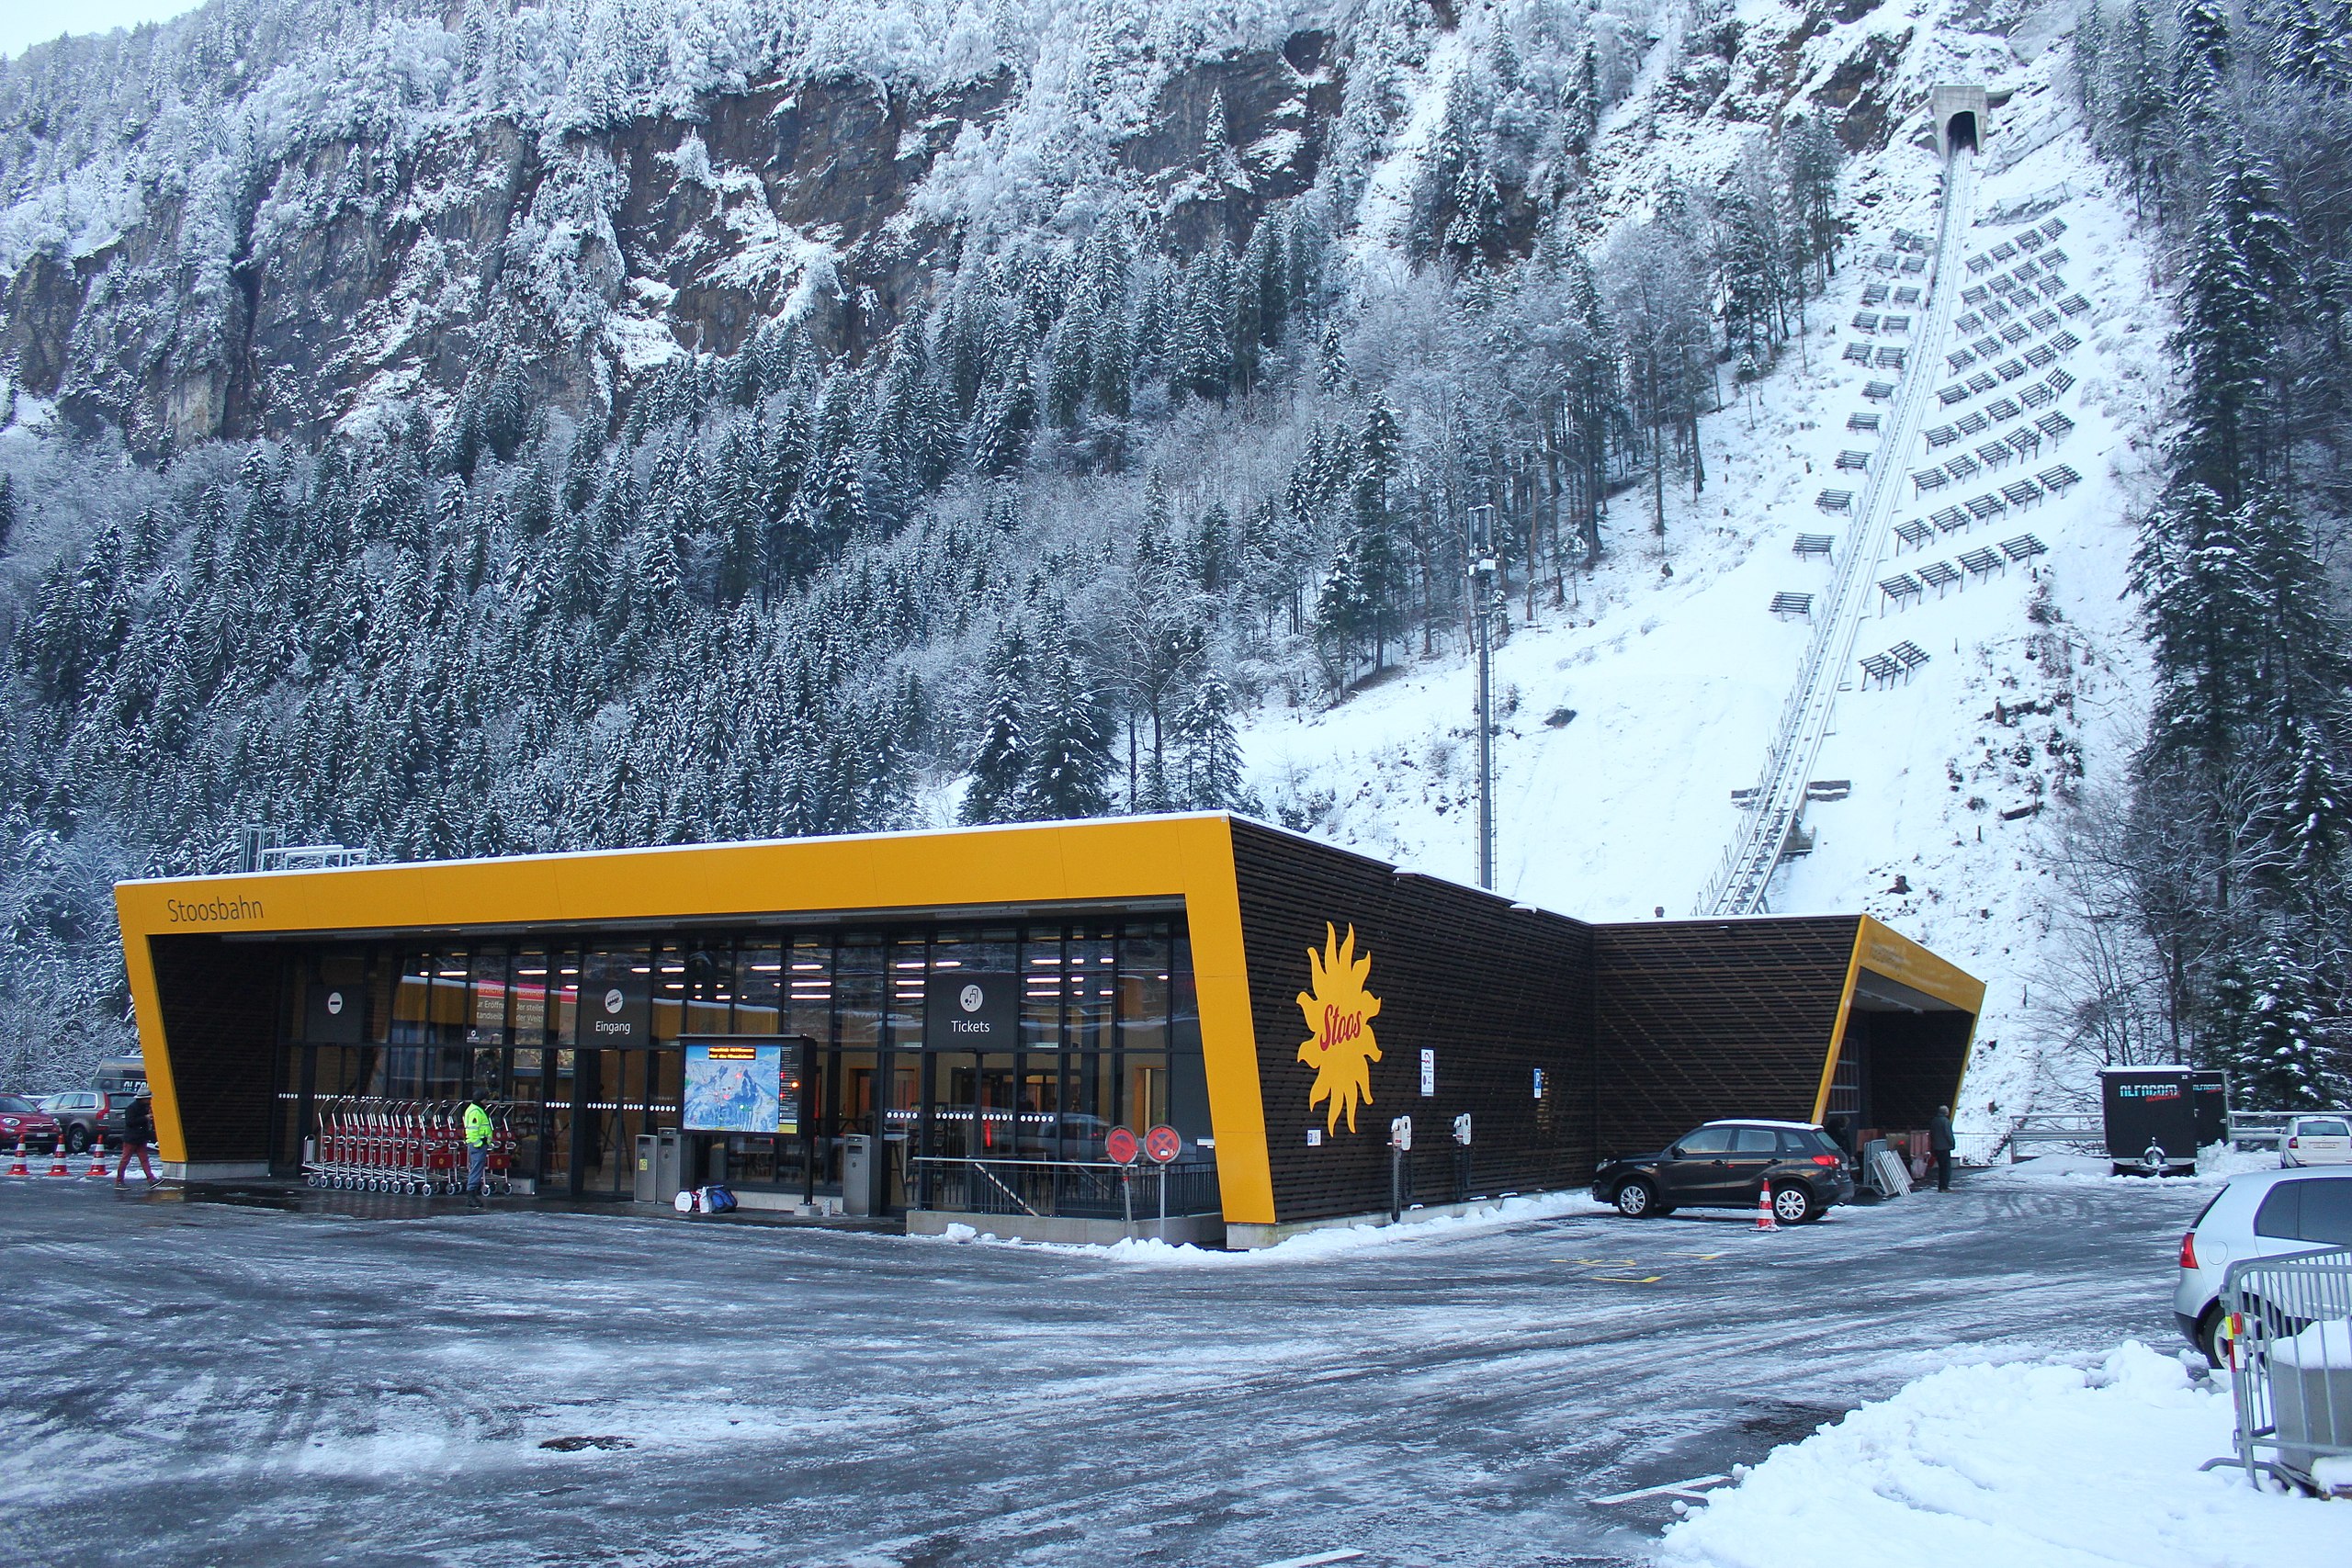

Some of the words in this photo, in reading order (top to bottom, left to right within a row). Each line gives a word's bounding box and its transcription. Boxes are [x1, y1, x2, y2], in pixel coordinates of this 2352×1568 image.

[167, 895, 264, 922] Stoosbahn
[595, 1021, 630, 1034] Eingang
[951, 1020, 990, 1032] Tickets
[1320, 1004, 1362, 1051] Stoos
